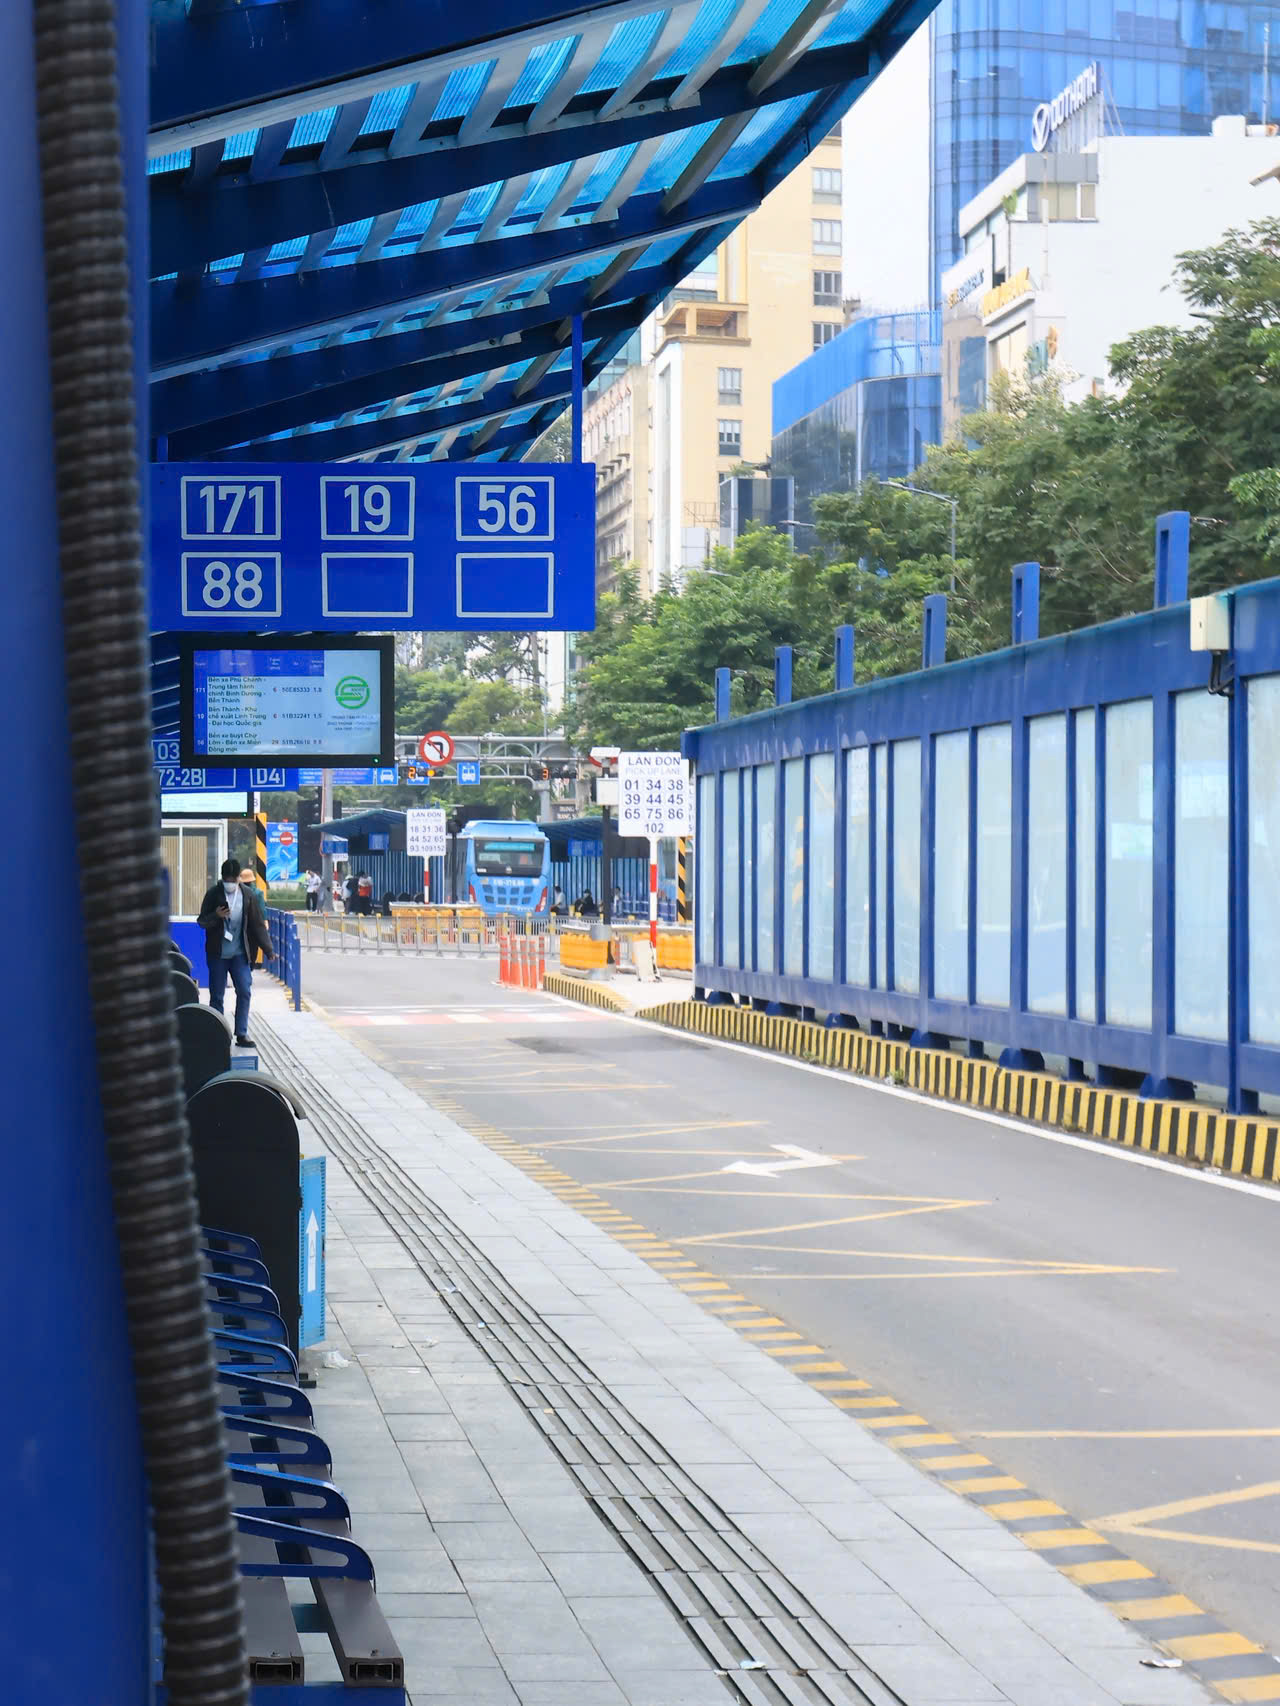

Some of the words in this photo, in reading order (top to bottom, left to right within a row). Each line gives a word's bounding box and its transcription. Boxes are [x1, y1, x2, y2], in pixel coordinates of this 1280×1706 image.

[200, 484, 264, 534] 171
[344, 484, 391, 533] 19
[478, 484, 536, 534] 56
[202, 561, 263, 609] 88
[157, 742, 180, 761] 03
[256, 768, 281, 785] D4
[542, 768, 549, 780] 3
[624, 780, 639, 791] 01
[646, 780, 662, 791] 34
[667, 780, 684, 791] 38
[624, 793, 641, 805] 39
[646, 793, 662, 805] 44
[667, 793, 684, 805] 45
[624, 808, 641, 820] 65
[646, 808, 662, 820] 75
[667, 808, 684, 820] 86
[645, 823, 664, 833] 102
